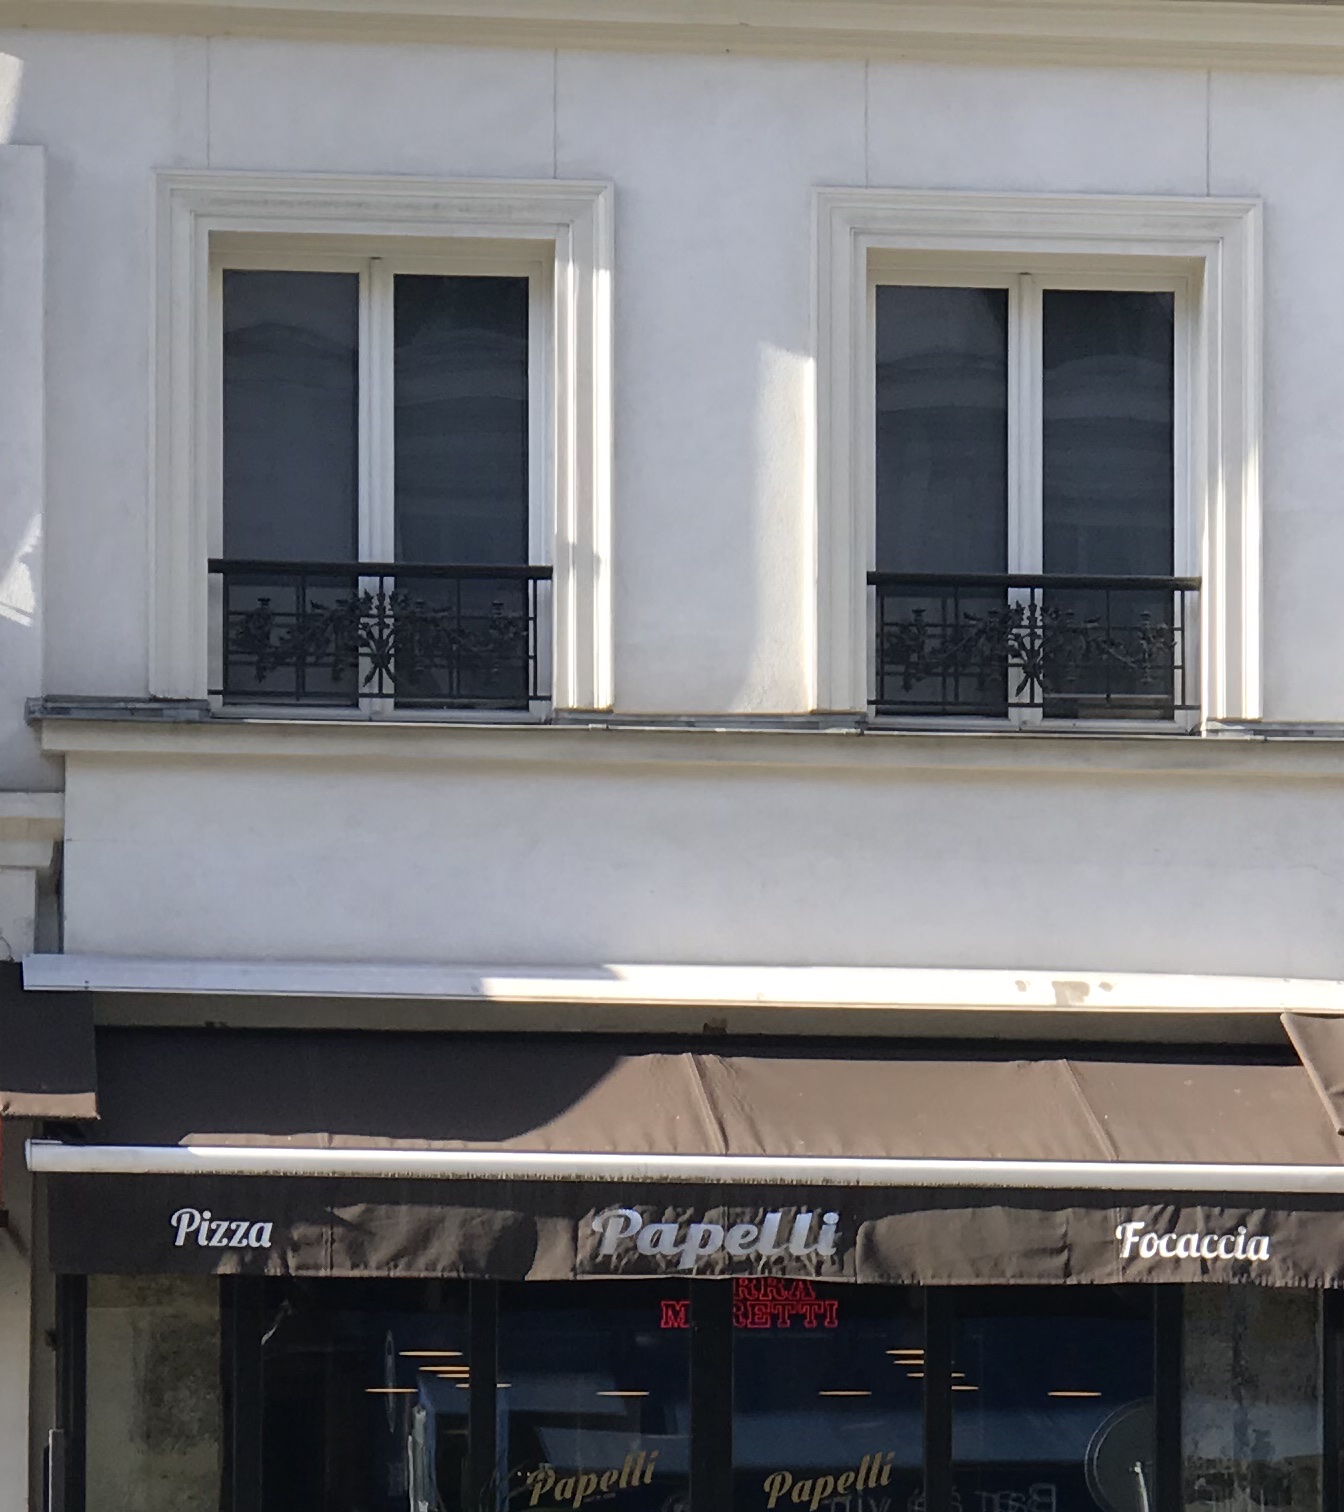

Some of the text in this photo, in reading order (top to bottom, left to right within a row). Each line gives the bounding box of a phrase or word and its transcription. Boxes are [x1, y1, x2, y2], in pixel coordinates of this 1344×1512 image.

[170, 1207, 274, 1249] Pizza
[591, 1207, 840, 1271] Papelli
[1115, 1220, 1271, 1261] Focaccia
[660, 1300, 839, 1329] MRETTI
[526, 1449, 660, 1510] Papelli
[763, 1451, 897, 1512] Papelli
